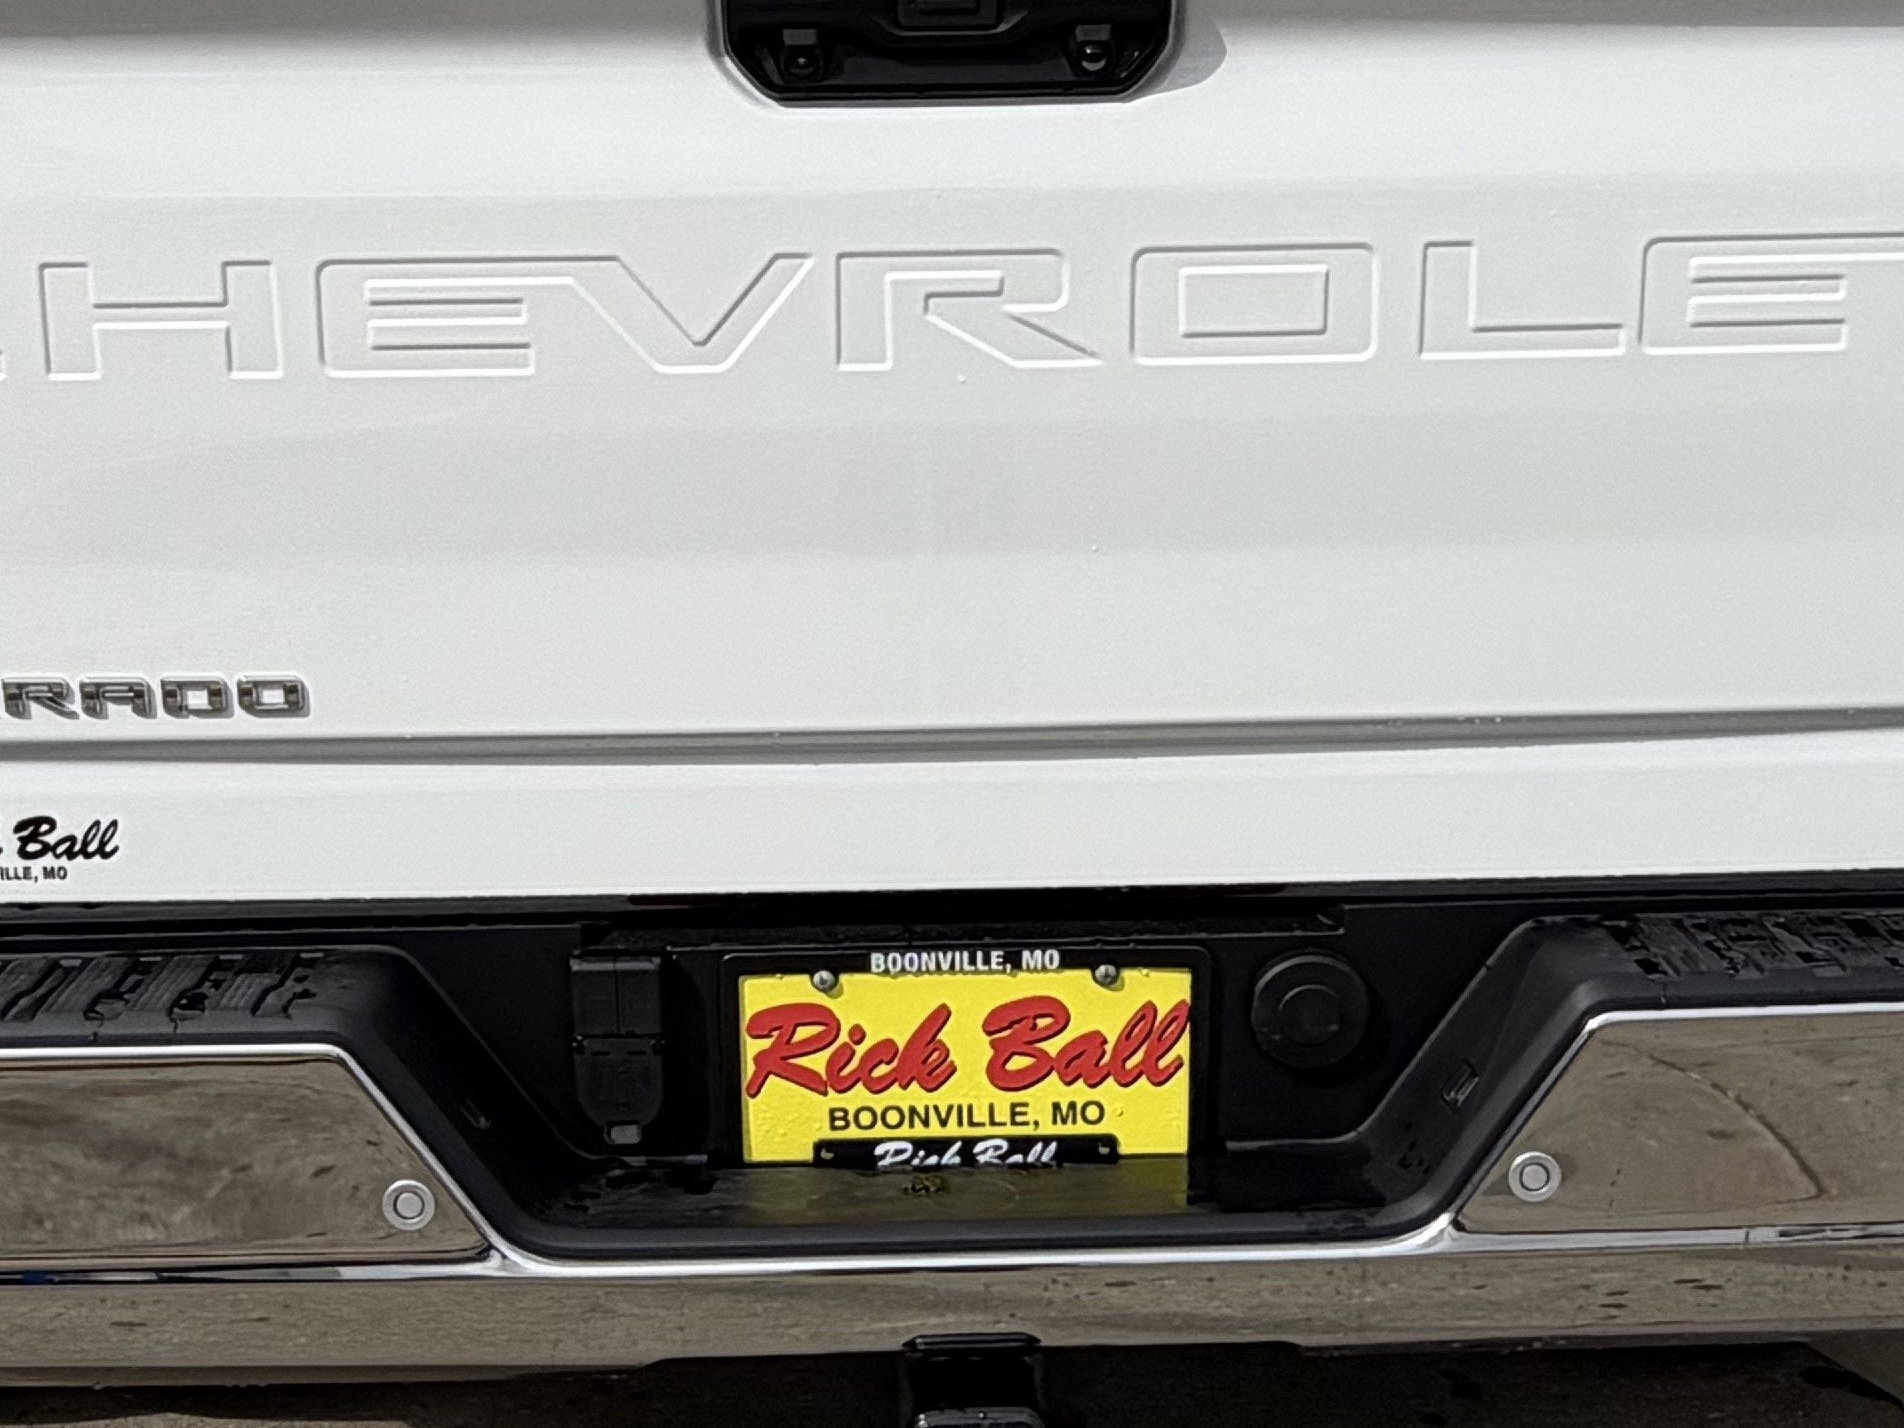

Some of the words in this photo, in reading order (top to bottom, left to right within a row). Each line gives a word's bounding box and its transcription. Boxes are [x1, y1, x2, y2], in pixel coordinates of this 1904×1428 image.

[13, 815, 120, 861] Ball
[42, 865, 68, 880] MO
[870, 950, 1011, 973] BOONVILLE,
[1021, 949, 1060, 970] MO
[746, 1002, 958, 1099] Rick
[982, 995, 1191, 1092] Ball
[828, 1102, 1040, 1132] BOONVILLE,
[1050, 1100, 1106, 1127] MO
